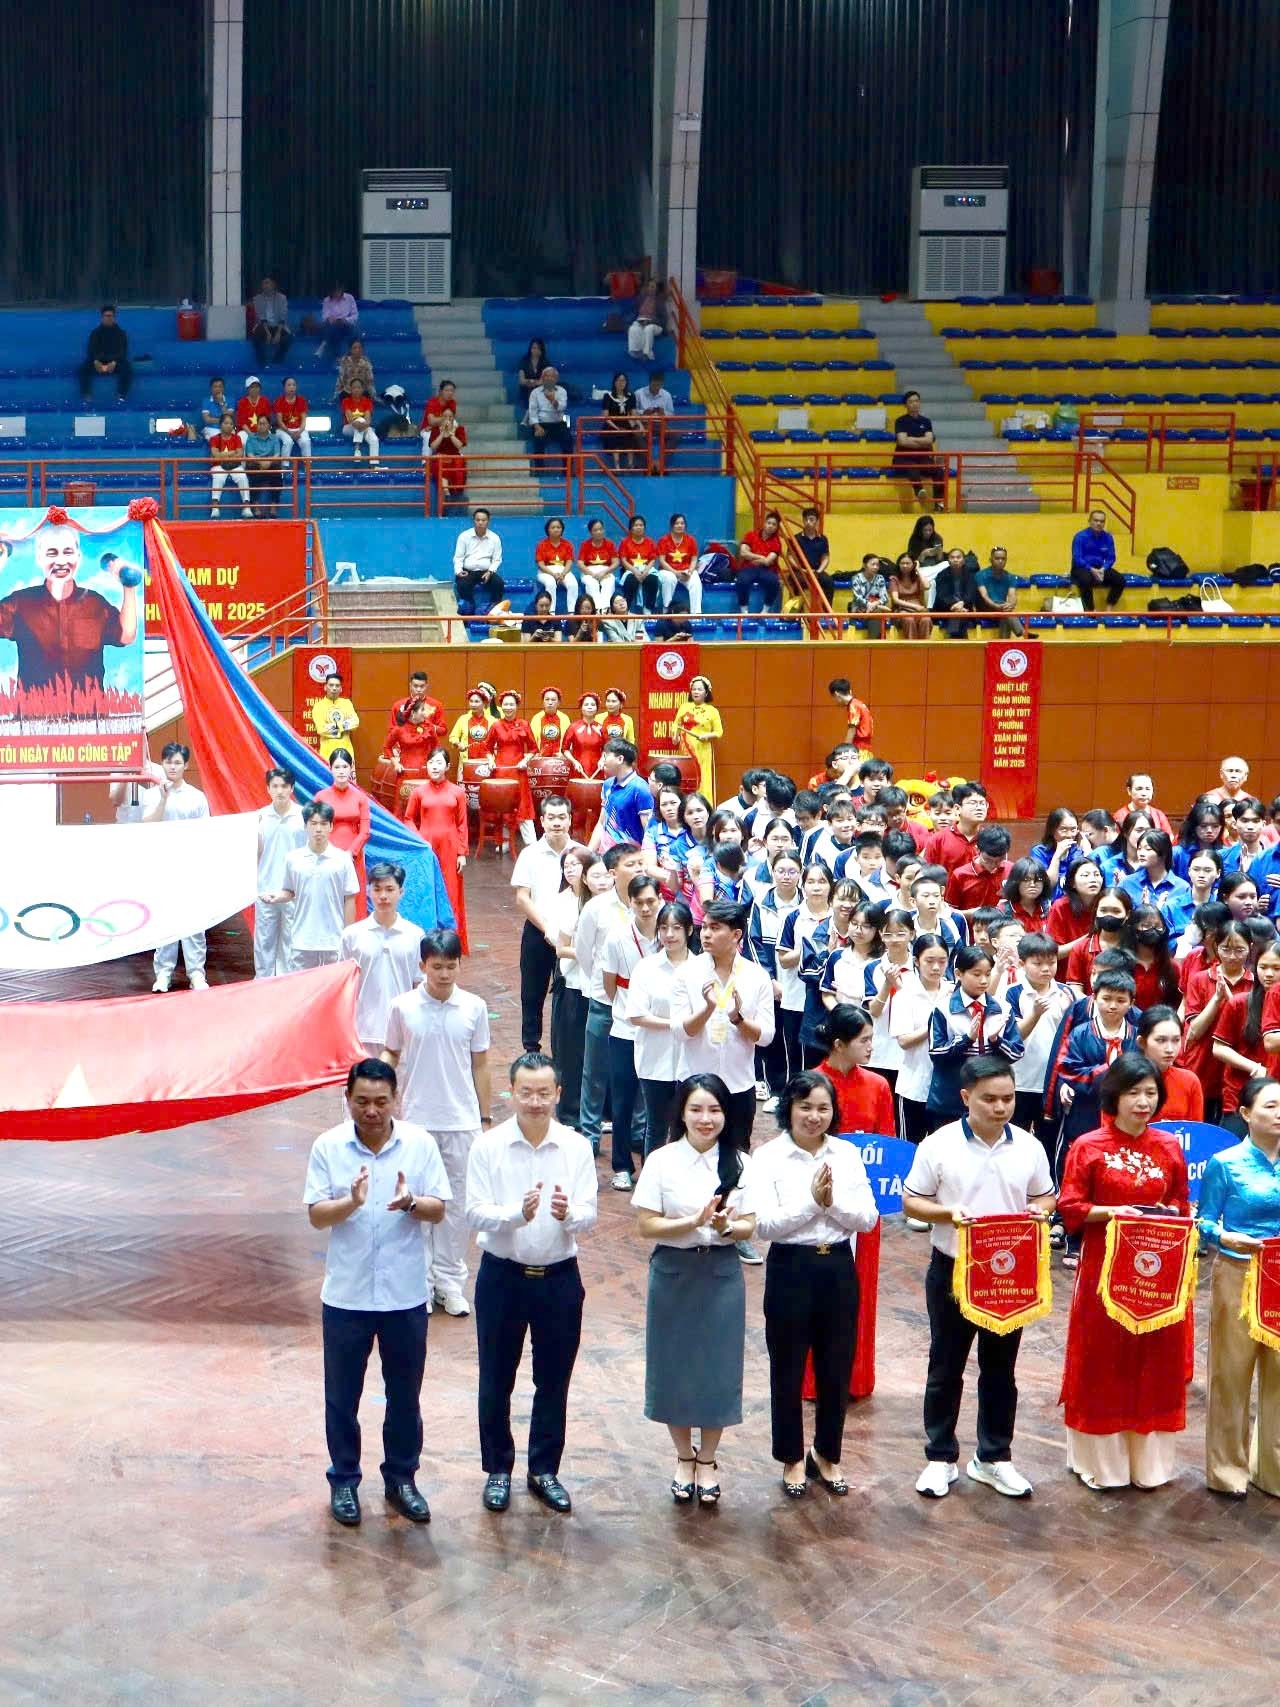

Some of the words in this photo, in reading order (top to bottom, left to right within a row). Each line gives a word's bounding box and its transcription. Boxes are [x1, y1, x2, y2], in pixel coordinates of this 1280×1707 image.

[217, 565, 240, 590] DỰ
[227, 602, 265, 621] 2025
[997, 682, 1015, 693] NHIỆT
[1015, 682, 1029, 693] LIỆT
[648, 692, 673, 710] NHANH
[994, 694, 1011, 704] CHÀO
[1004, 707, 1015, 718] HỘI
[653, 721, 667, 738] CAO
[0, 746, 17, 763] TÔI
[19, 744, 49, 763] NGÀY
[52, 744, 75, 762] NÀO
[78, 743, 108, 762] CŨNG
